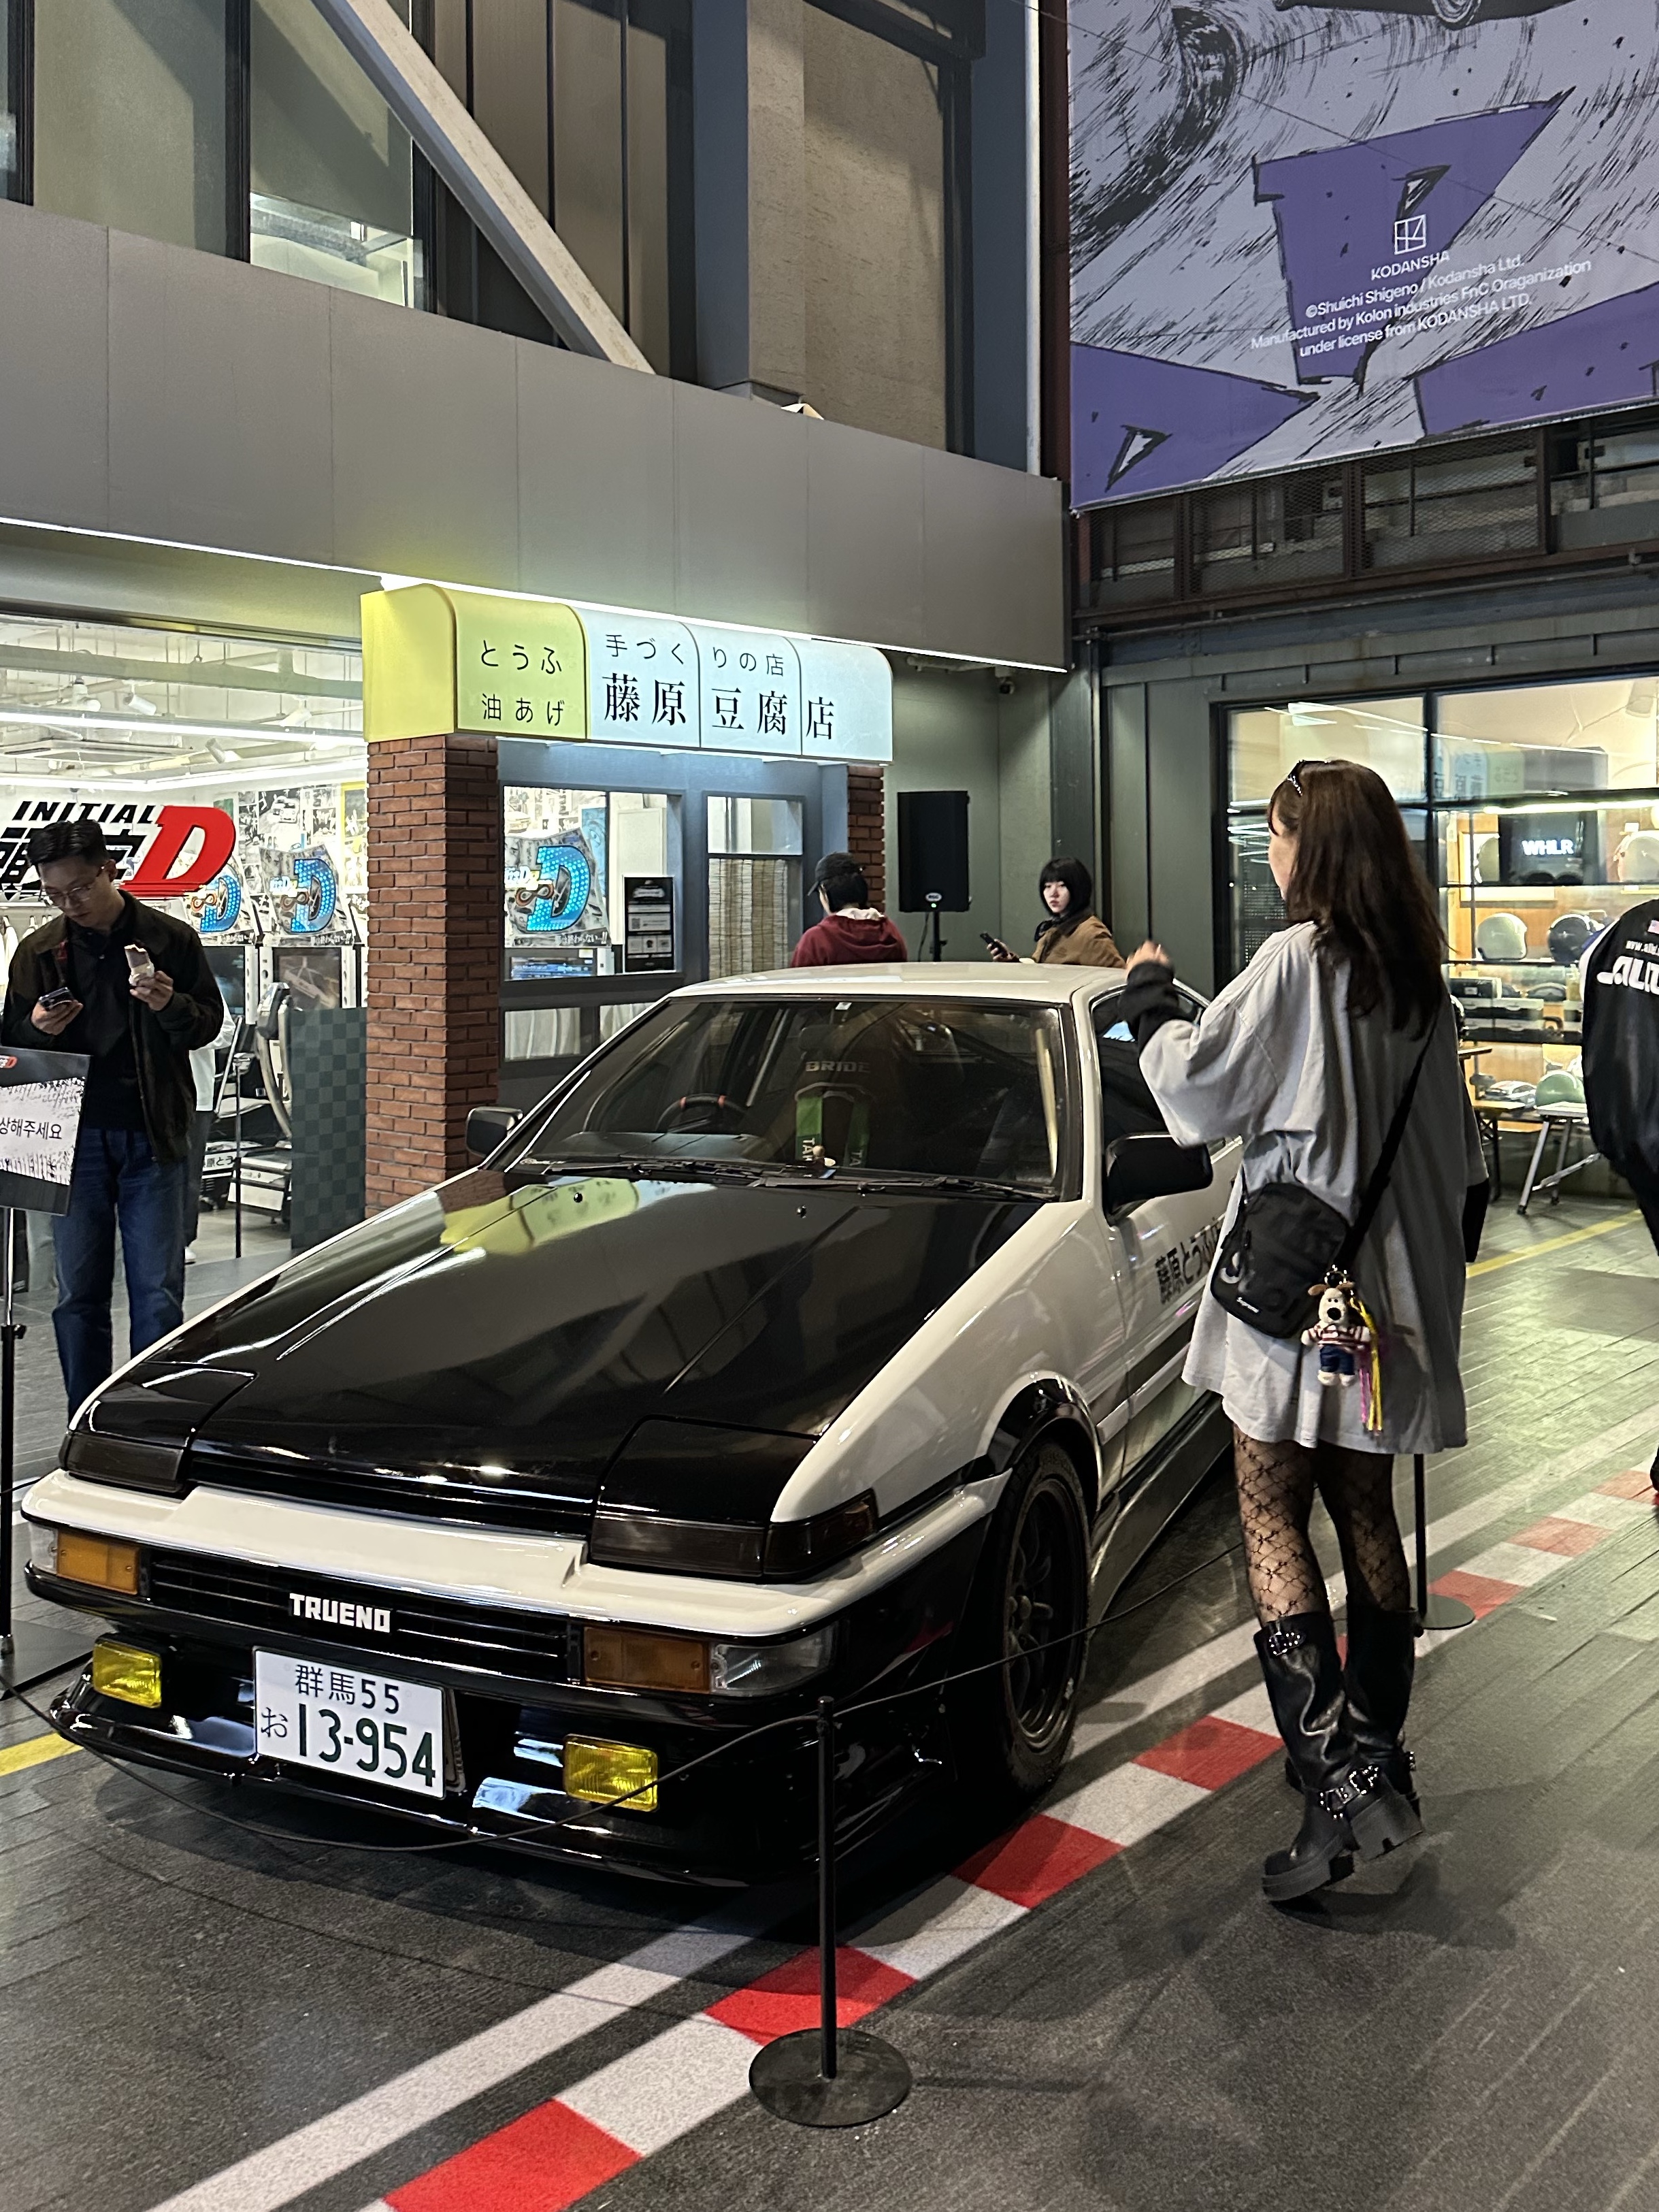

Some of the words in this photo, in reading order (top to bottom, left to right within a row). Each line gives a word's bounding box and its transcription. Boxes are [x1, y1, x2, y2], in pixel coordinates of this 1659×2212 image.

[1365, 283, 1419, 304] Shigeno
[1428, 262, 1495, 289] Kodansha
[1498, 255, 1525, 272] Ltd.
[1370, 250, 1449, 280] KODANSHA
[1251, 319, 1336, 350] Manufactured
[1338, 317, 1355, 331] by
[1356, 308, 1392, 326] Kolon
[1461, 282, 1490, 299] FnC
[1300, 339, 1337, 357] under
[1338, 330, 1383, 349] license
[1385, 324, 1416, 340] from
[1417, 300, 1500, 331] KODANSHA
[1502, 293, 1532, 310] LTD.
[480, 640, 562, 674] とうふ
[606, 634, 785, 677] 手づくりの店
[482, 693, 565, 727] 油あげ
[602, 672, 835, 741] 藤原豆腐店
[12, 800, 156, 824] INITIAL
[118, 805, 236, 898] D
[1522, 839, 1574, 856] WHLR
[805, 1060, 870, 1073] BRIDE
[289, 1593, 391, 1633] TRUENO
[261, 1706, 288, 1738] お
[299, 1703, 436, 1787] 13-954
